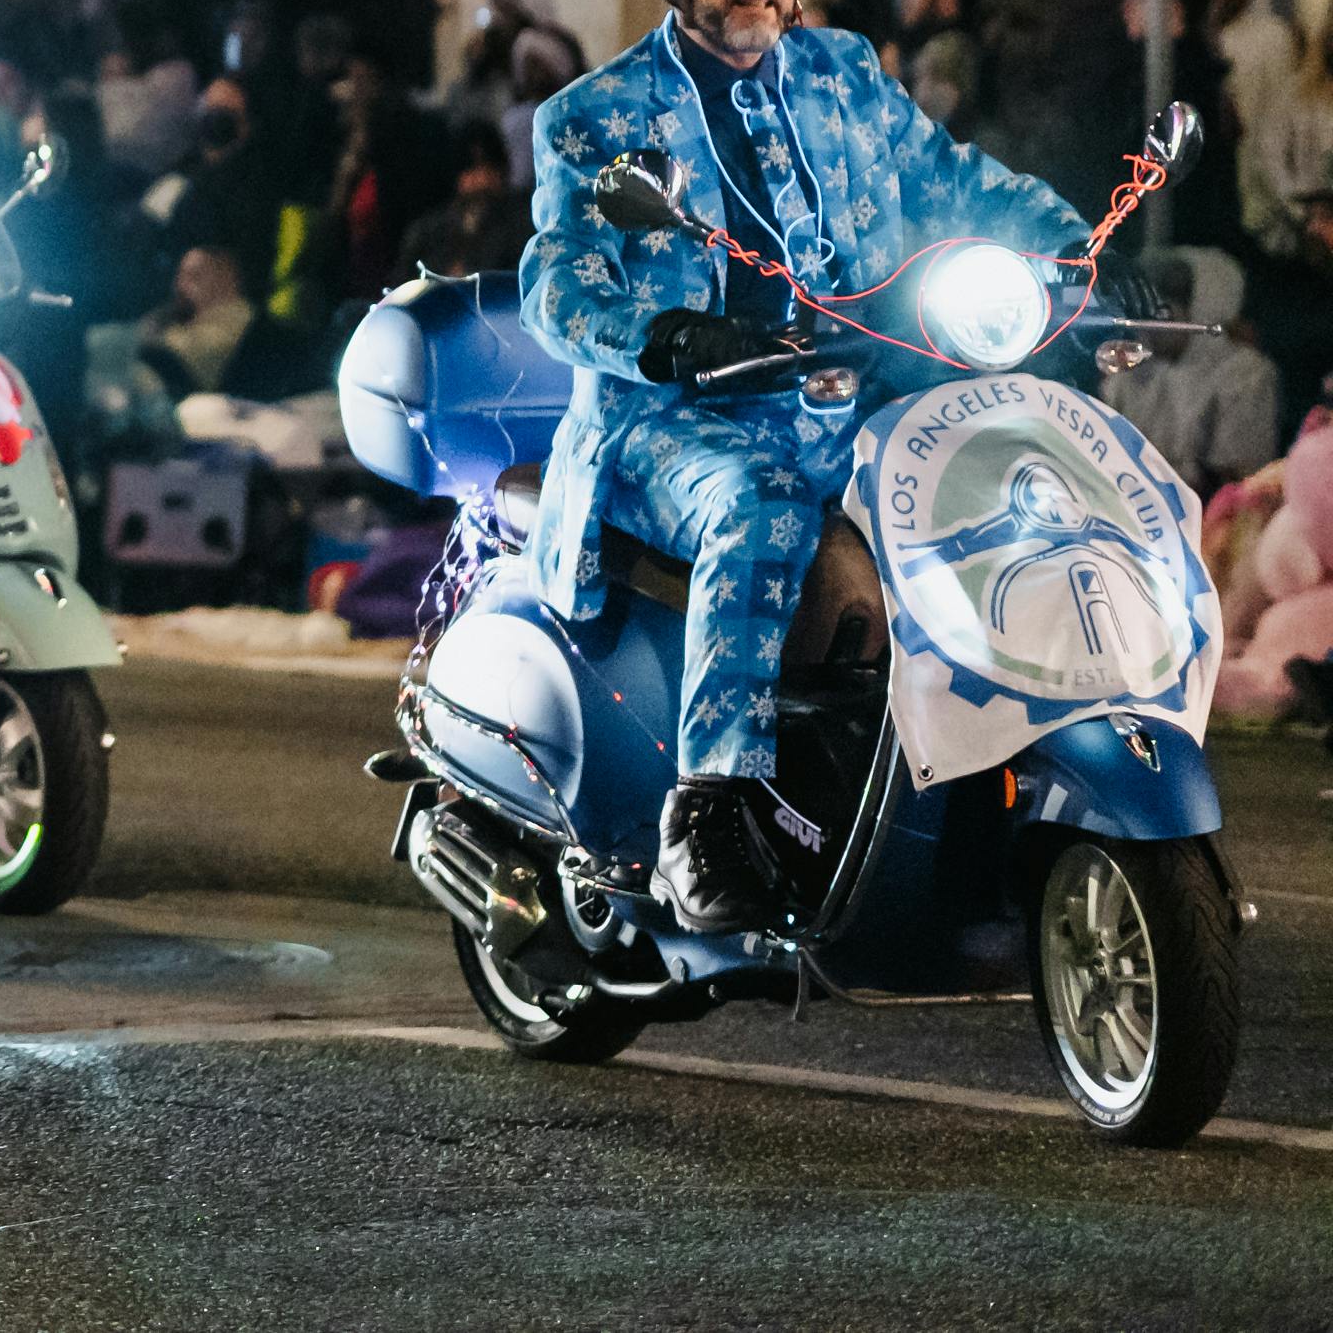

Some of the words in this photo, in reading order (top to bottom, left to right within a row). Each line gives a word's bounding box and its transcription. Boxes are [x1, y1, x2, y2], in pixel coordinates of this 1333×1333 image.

[891, 471, 919, 532] LOS
[906, 381, 1026, 461] ANGELES
[1038, 386, 1109, 464] VESPA
[1115, 470, 1165, 544] CLUB
[1074, 666, 1114, 686] EST.
[773, 806, 821, 854] GIVI
